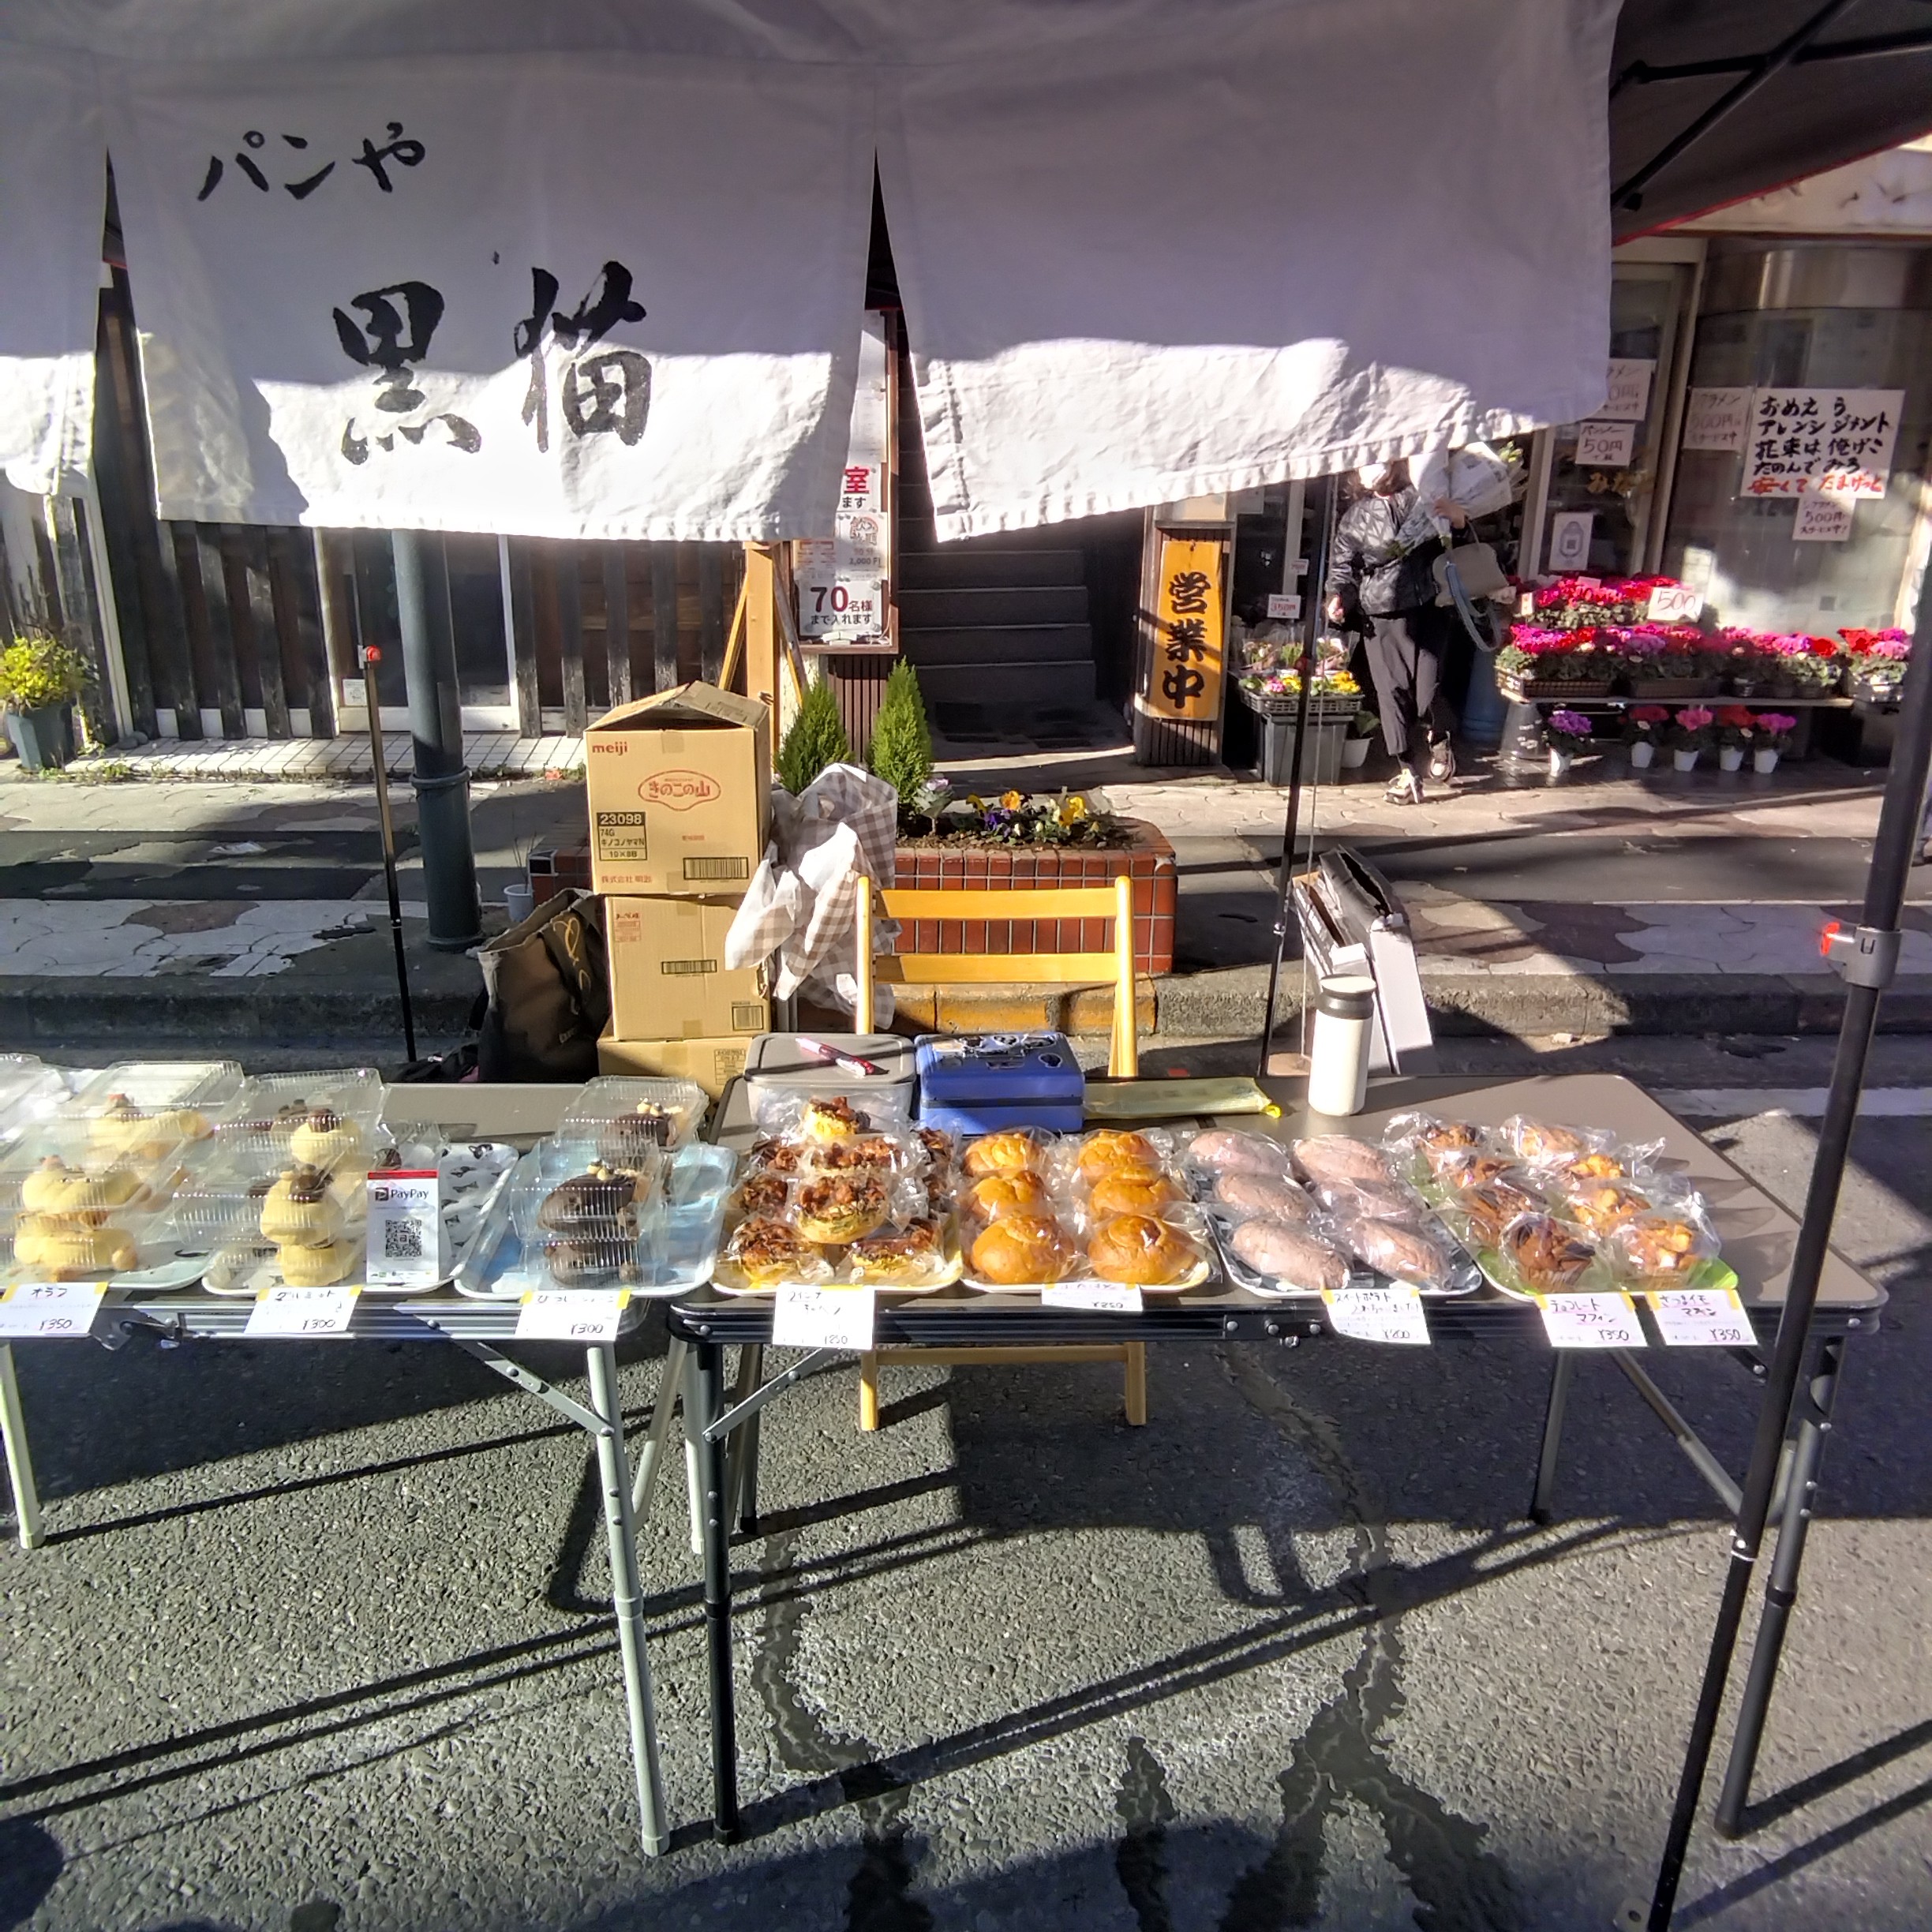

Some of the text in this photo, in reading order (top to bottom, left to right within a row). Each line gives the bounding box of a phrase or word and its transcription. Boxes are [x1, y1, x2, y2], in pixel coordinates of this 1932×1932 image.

[197, 122, 426, 202] パンや
[844, 466, 870, 494] 室
[842, 496, 867, 509] ます
[811, 614, 872, 625] まで入れます
[1163, 571, 1211, 709] 営業中
[592, 741, 628, 755] meiji
[649, 781, 710, 799] きのこの山
[600, 814, 642, 826] 23098
[391, 1189, 429, 1200] PayPay
